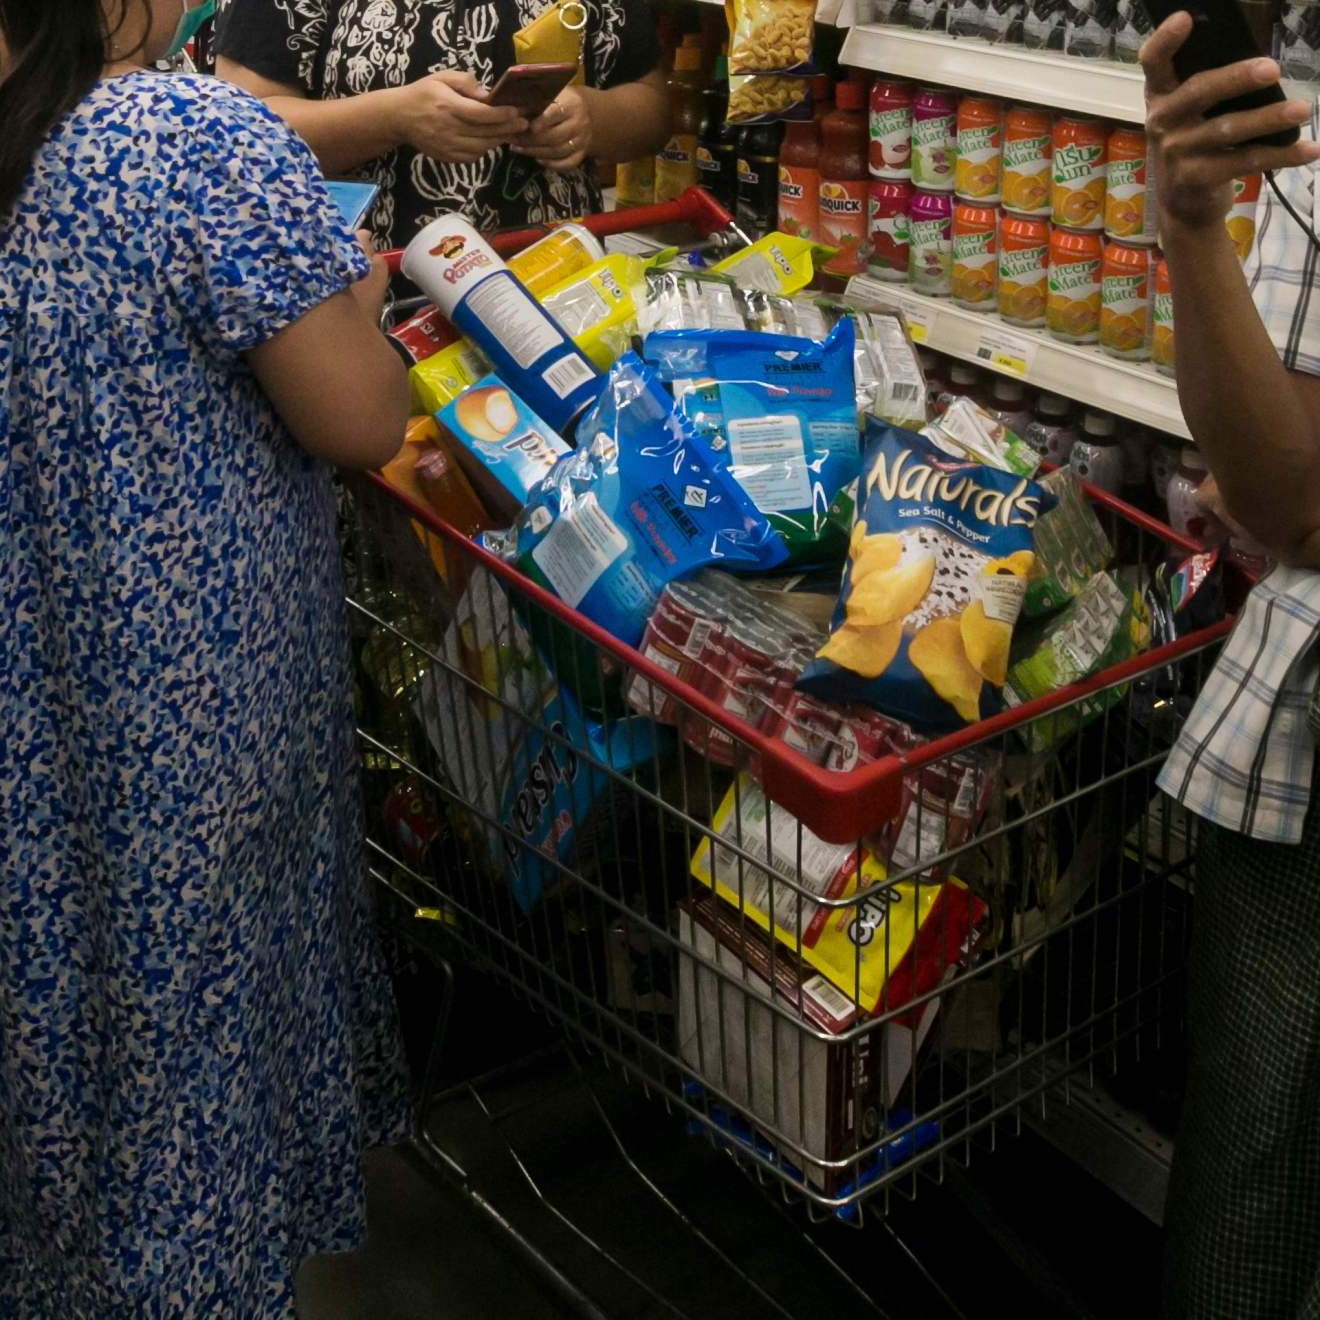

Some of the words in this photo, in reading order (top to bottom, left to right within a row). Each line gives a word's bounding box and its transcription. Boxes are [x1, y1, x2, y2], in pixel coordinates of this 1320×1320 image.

[764, 362, 824, 373] PREMIER
[652, 483, 699, 537] PREMIER
[864, 448, 1041, 528] Naturals
[898, 508, 920, 519] Sea
[923, 505, 946, 520] Salt
[948, 514, 956, 525] &
[956, 519, 991, 544] Pepper
